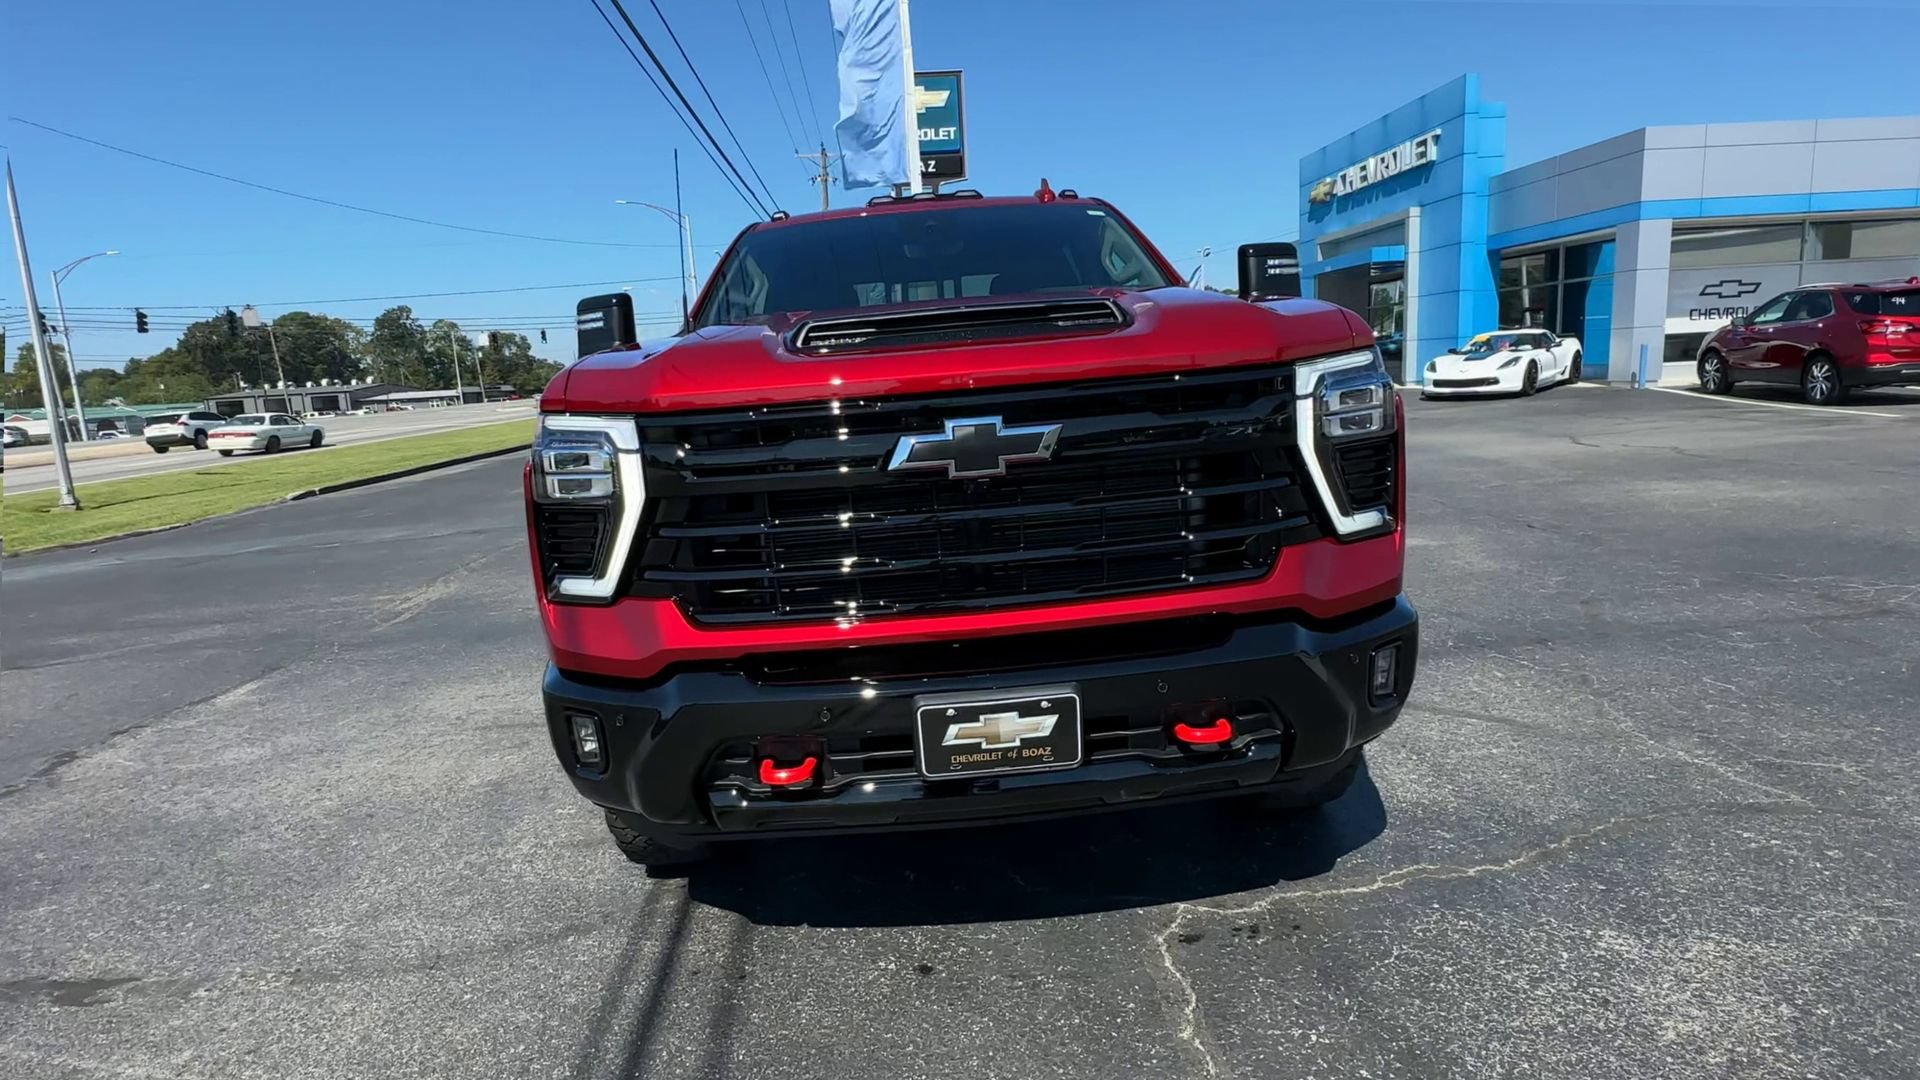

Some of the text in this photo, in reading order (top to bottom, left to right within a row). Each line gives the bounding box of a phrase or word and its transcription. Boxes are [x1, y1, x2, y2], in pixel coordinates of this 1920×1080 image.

[1333, 129, 1442, 196] CHEVROLET
[951, 747, 1052, 763] CHEVROLET of BOAZ
